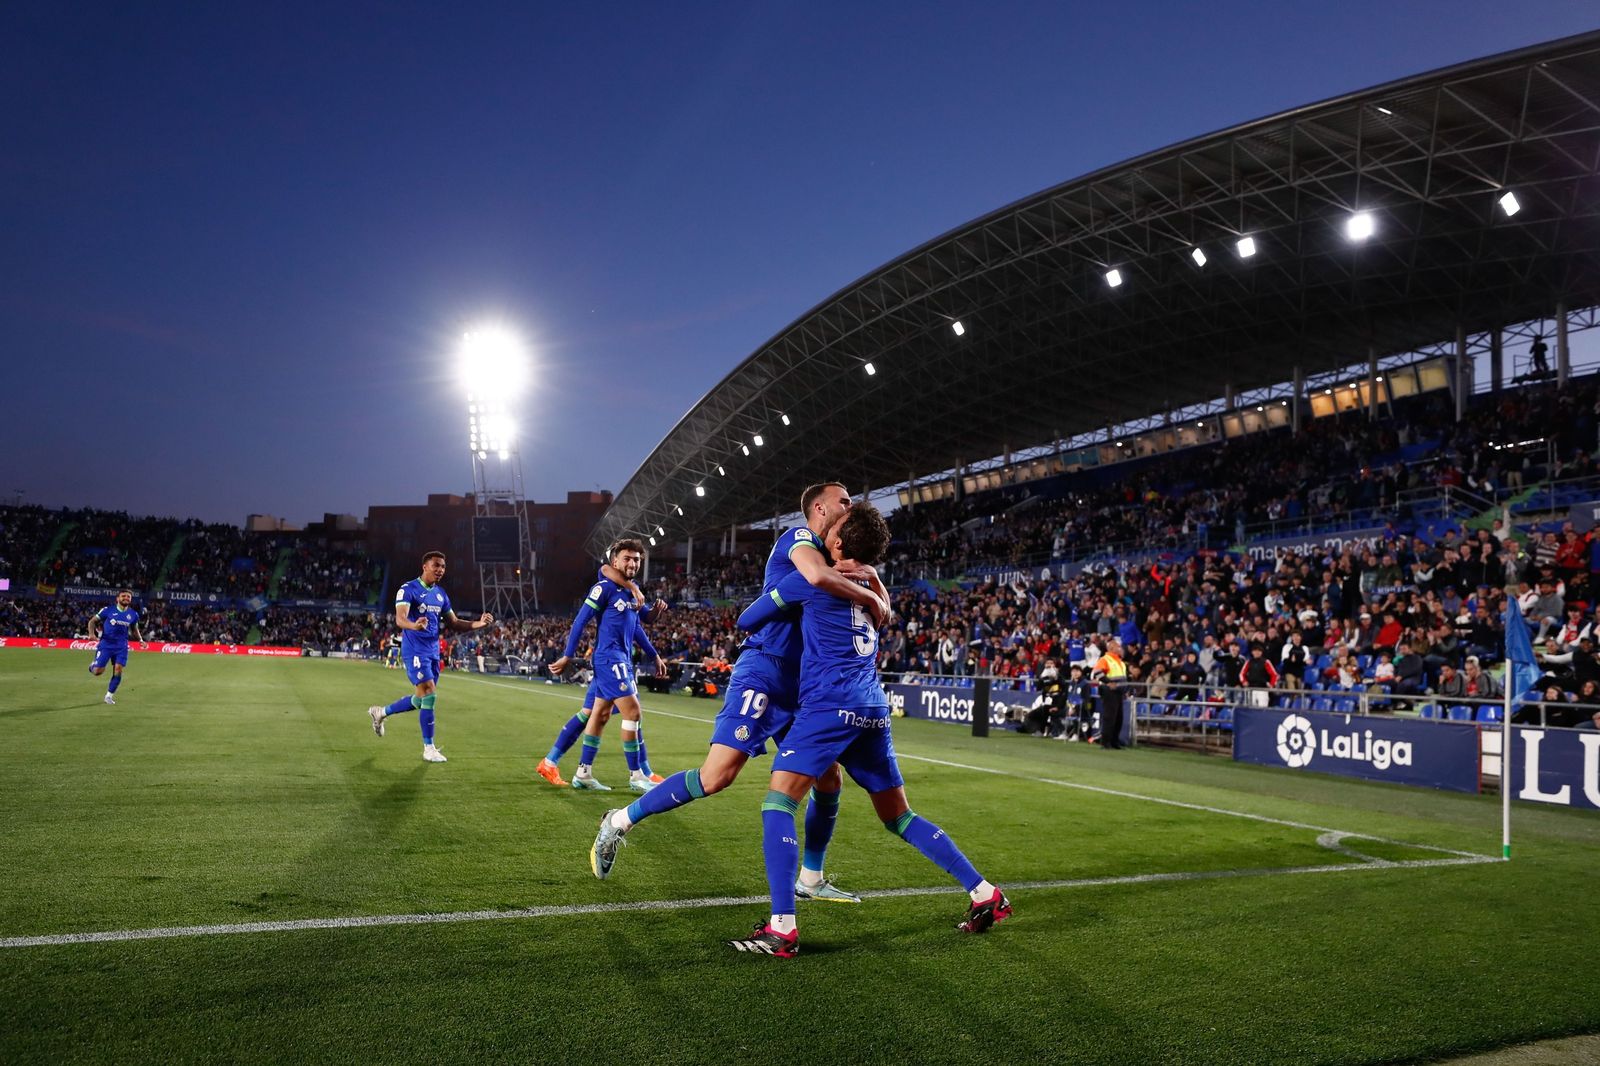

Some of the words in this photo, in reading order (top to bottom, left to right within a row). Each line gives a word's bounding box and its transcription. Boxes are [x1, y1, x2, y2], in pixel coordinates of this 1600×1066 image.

[170, 592, 201, 601] LUJISA
[850, 599, 877, 656] 5
[413, 655, 421, 669] 4
[739, 689, 768, 719] 19
[887, 690, 904, 708] Liga
[921, 690, 1005, 724] Motoro
[1321, 730, 1412, 770] LaLiga
